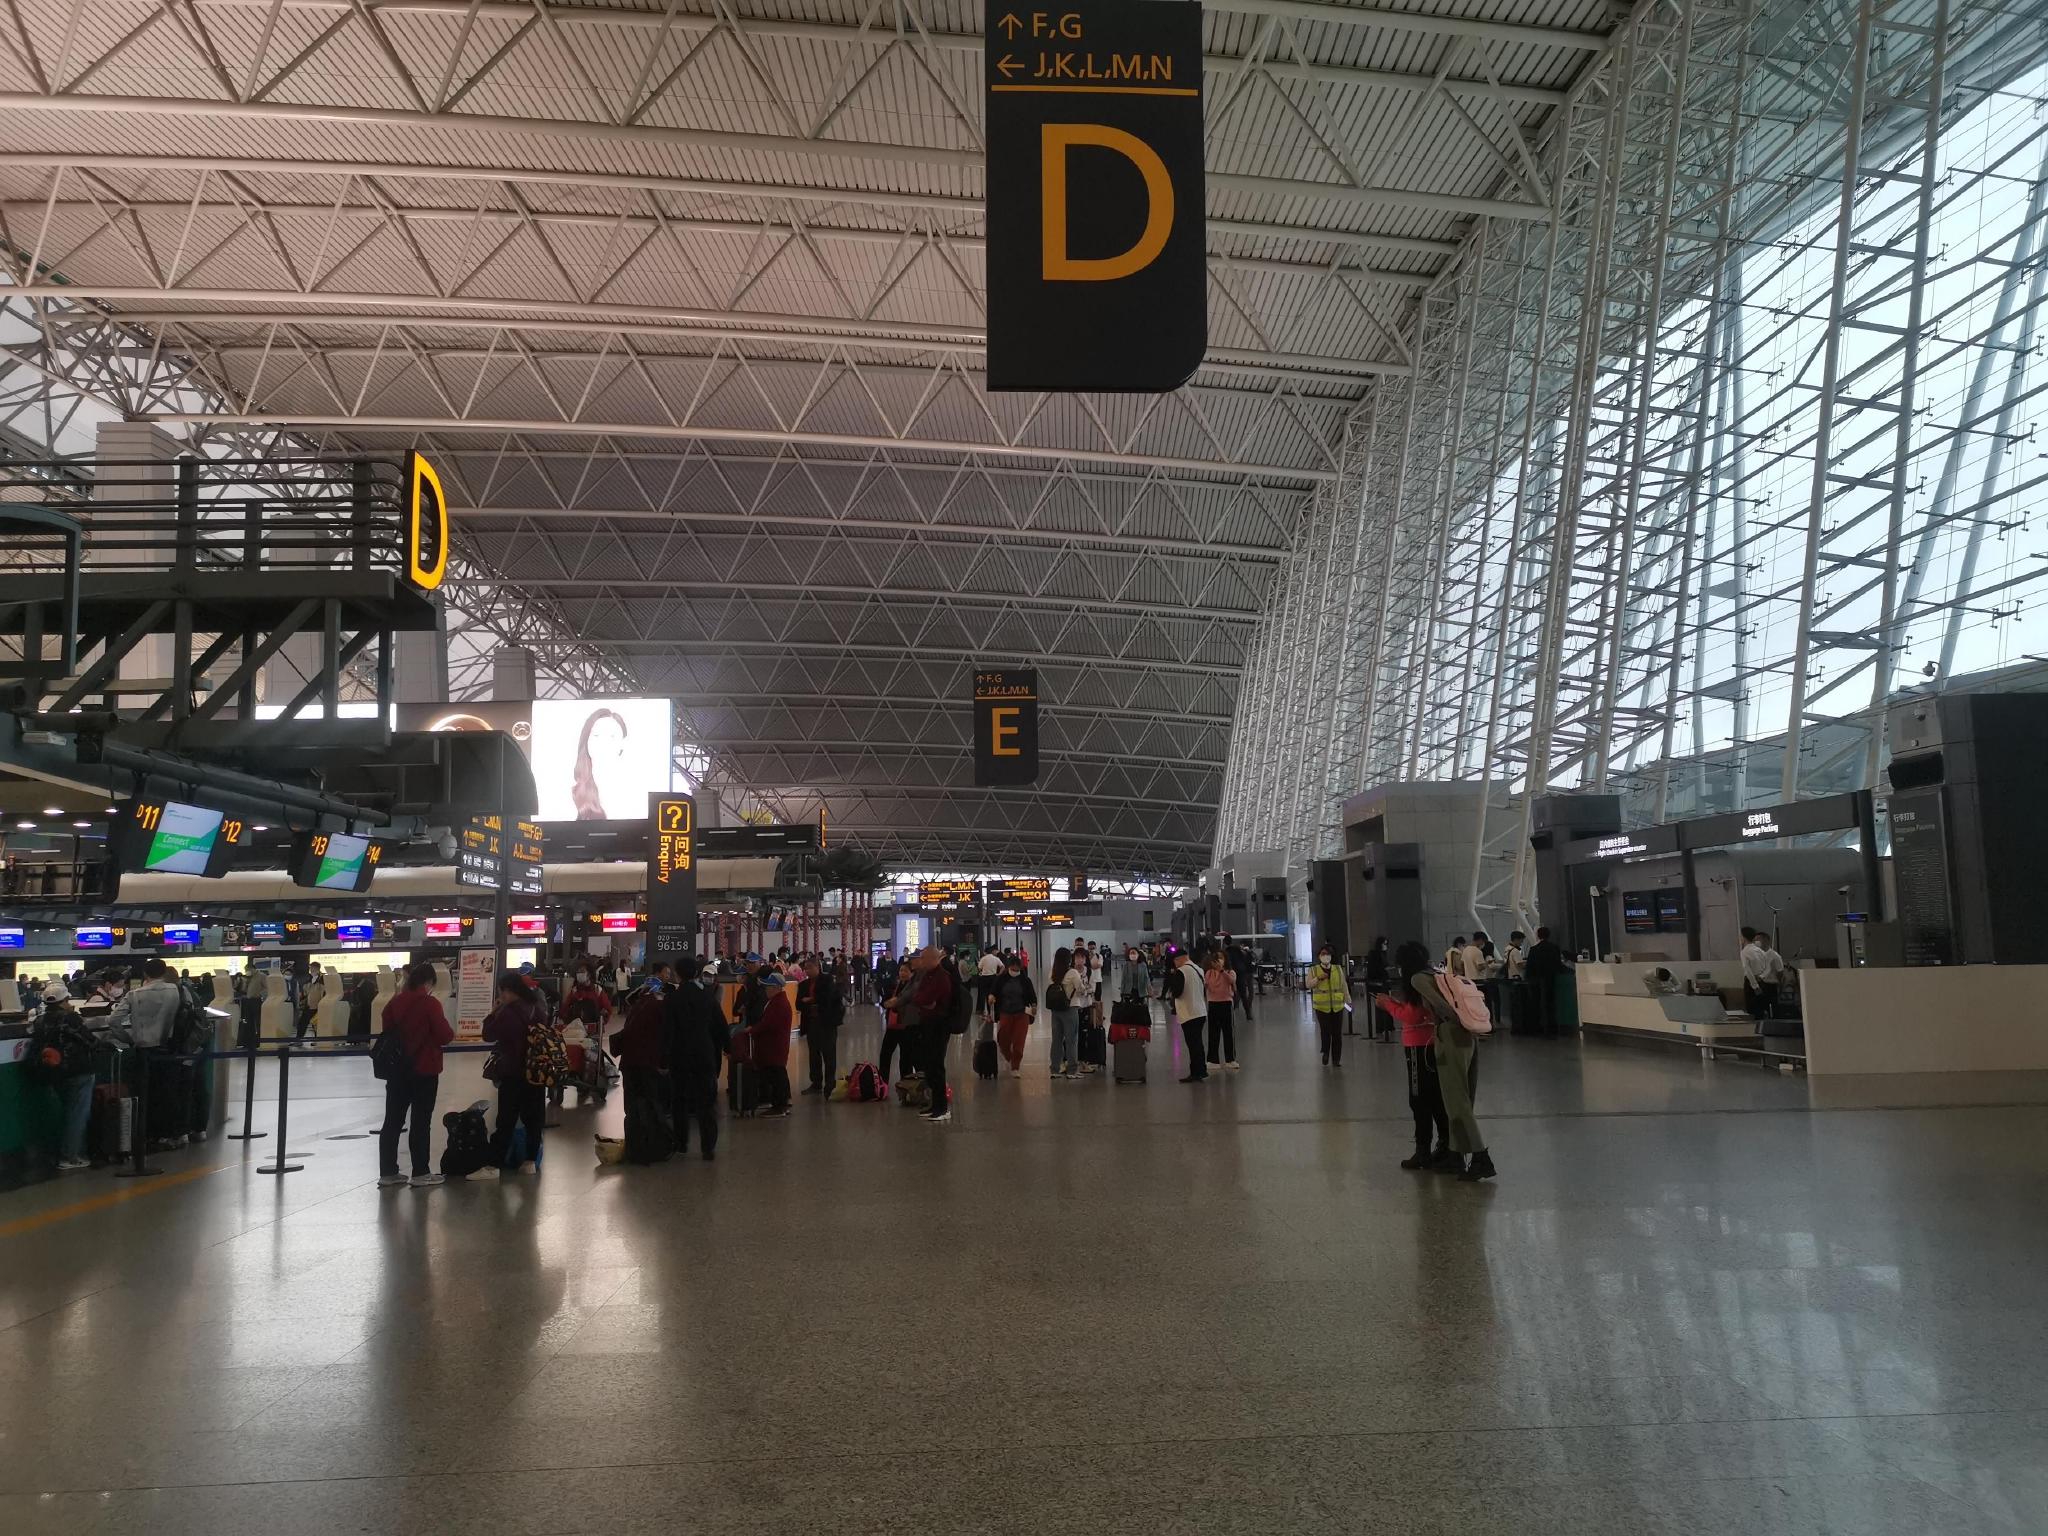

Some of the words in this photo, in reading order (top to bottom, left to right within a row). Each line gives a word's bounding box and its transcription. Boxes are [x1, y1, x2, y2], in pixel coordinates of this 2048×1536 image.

[1032, 13, 1082, 39] F,G
[1033, 52, 1173, 81] J,K,L,M,N
[1041, 123, 1175, 281] D
[411, 449, 448, 590] D
[991, 707, 1020, 756] E
[658, 836, 672, 884] Enquiry
[674, 836, 690, 870] 问询
[657, 940, 689, 951] 96158
